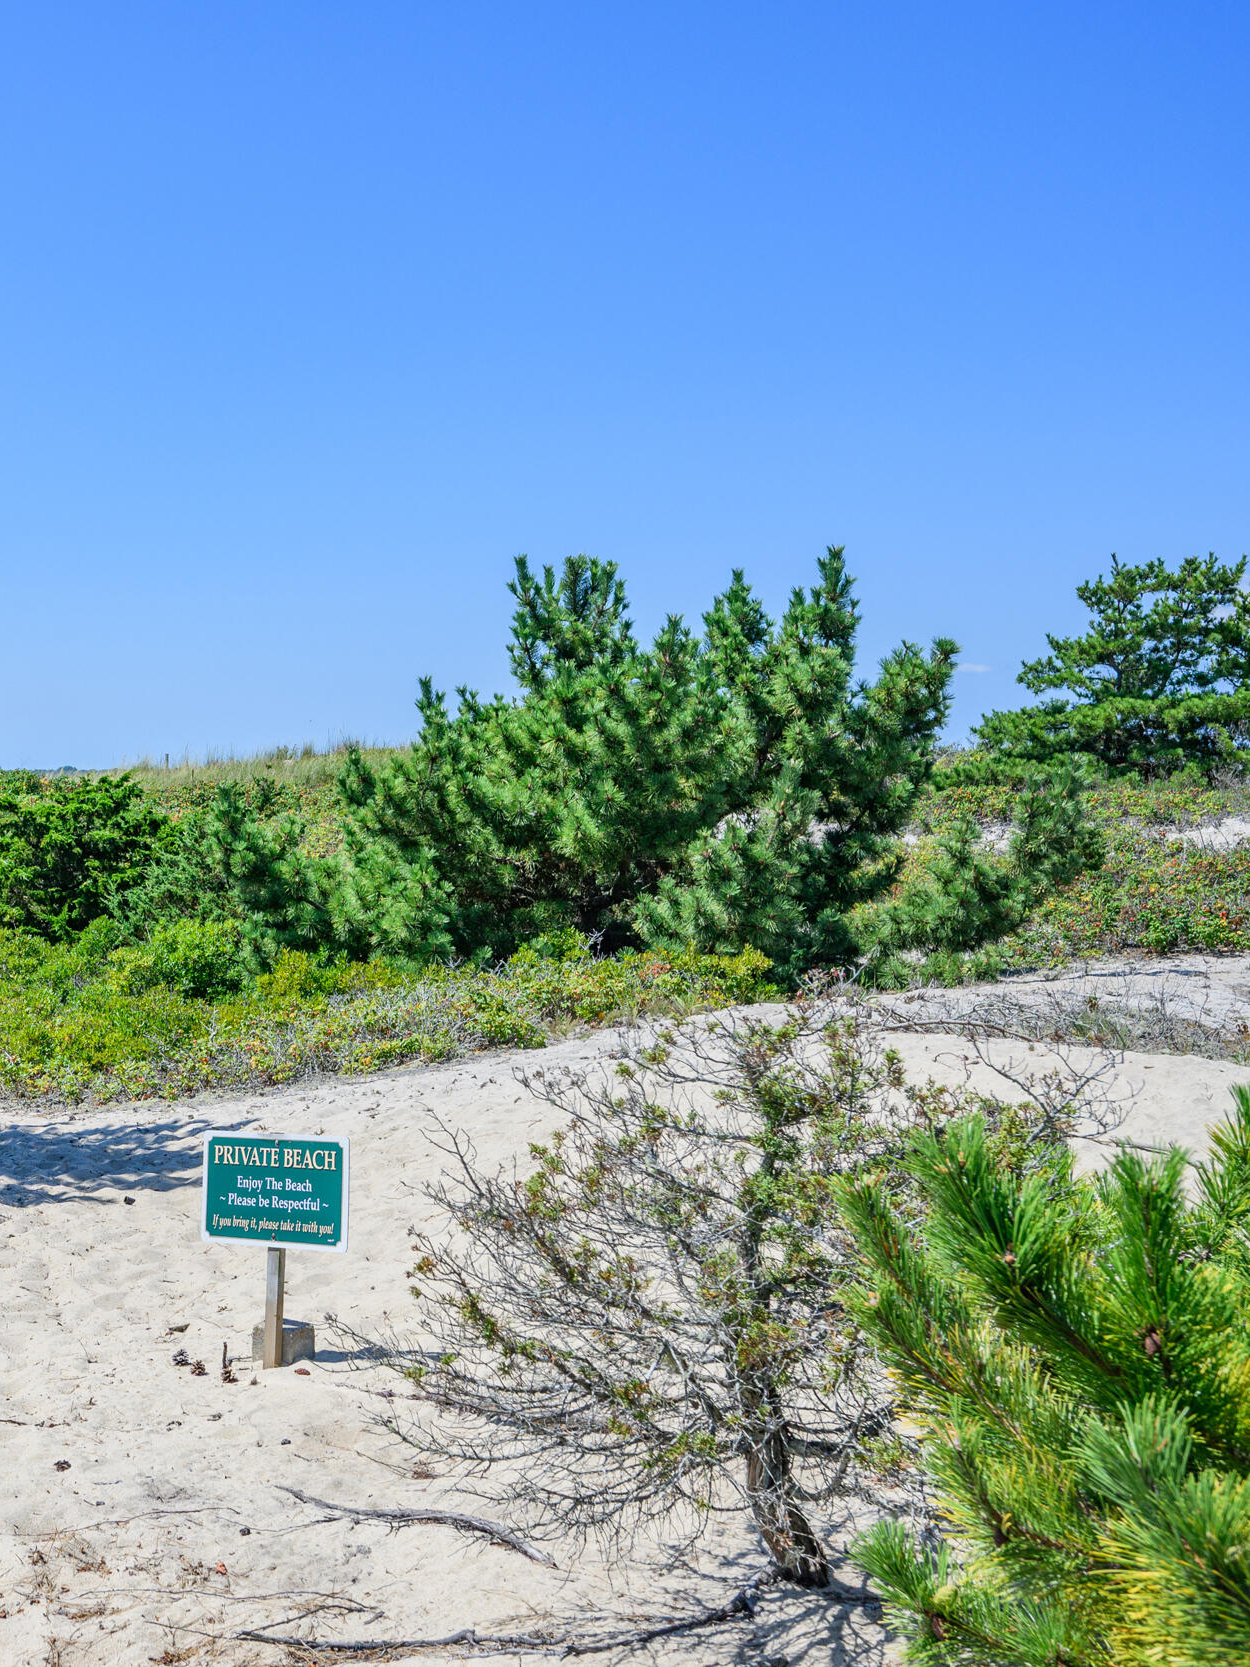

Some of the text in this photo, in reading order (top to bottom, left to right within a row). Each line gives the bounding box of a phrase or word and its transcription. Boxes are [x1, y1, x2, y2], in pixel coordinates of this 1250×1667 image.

[214, 1145, 337, 1170] PRIVATE BEACH
[237, 1176, 312, 1192] Enjoy The Beach
[228, 1193, 256, 1207] Please
[258, 1195, 269, 1207] be
[272, 1195, 320, 1212] Respectful
[212, 1214, 219, 1229] If
[219, 1217, 231, 1230] you
[233, 1216, 249, 1232] bring
[258, 1217, 279, 1232] please
[280, 1219, 294, 1232] take
[295, 1220, 301, 1232] it
[302, 1221, 318, 1234] with
[319, 1223, 334, 1237] you!
